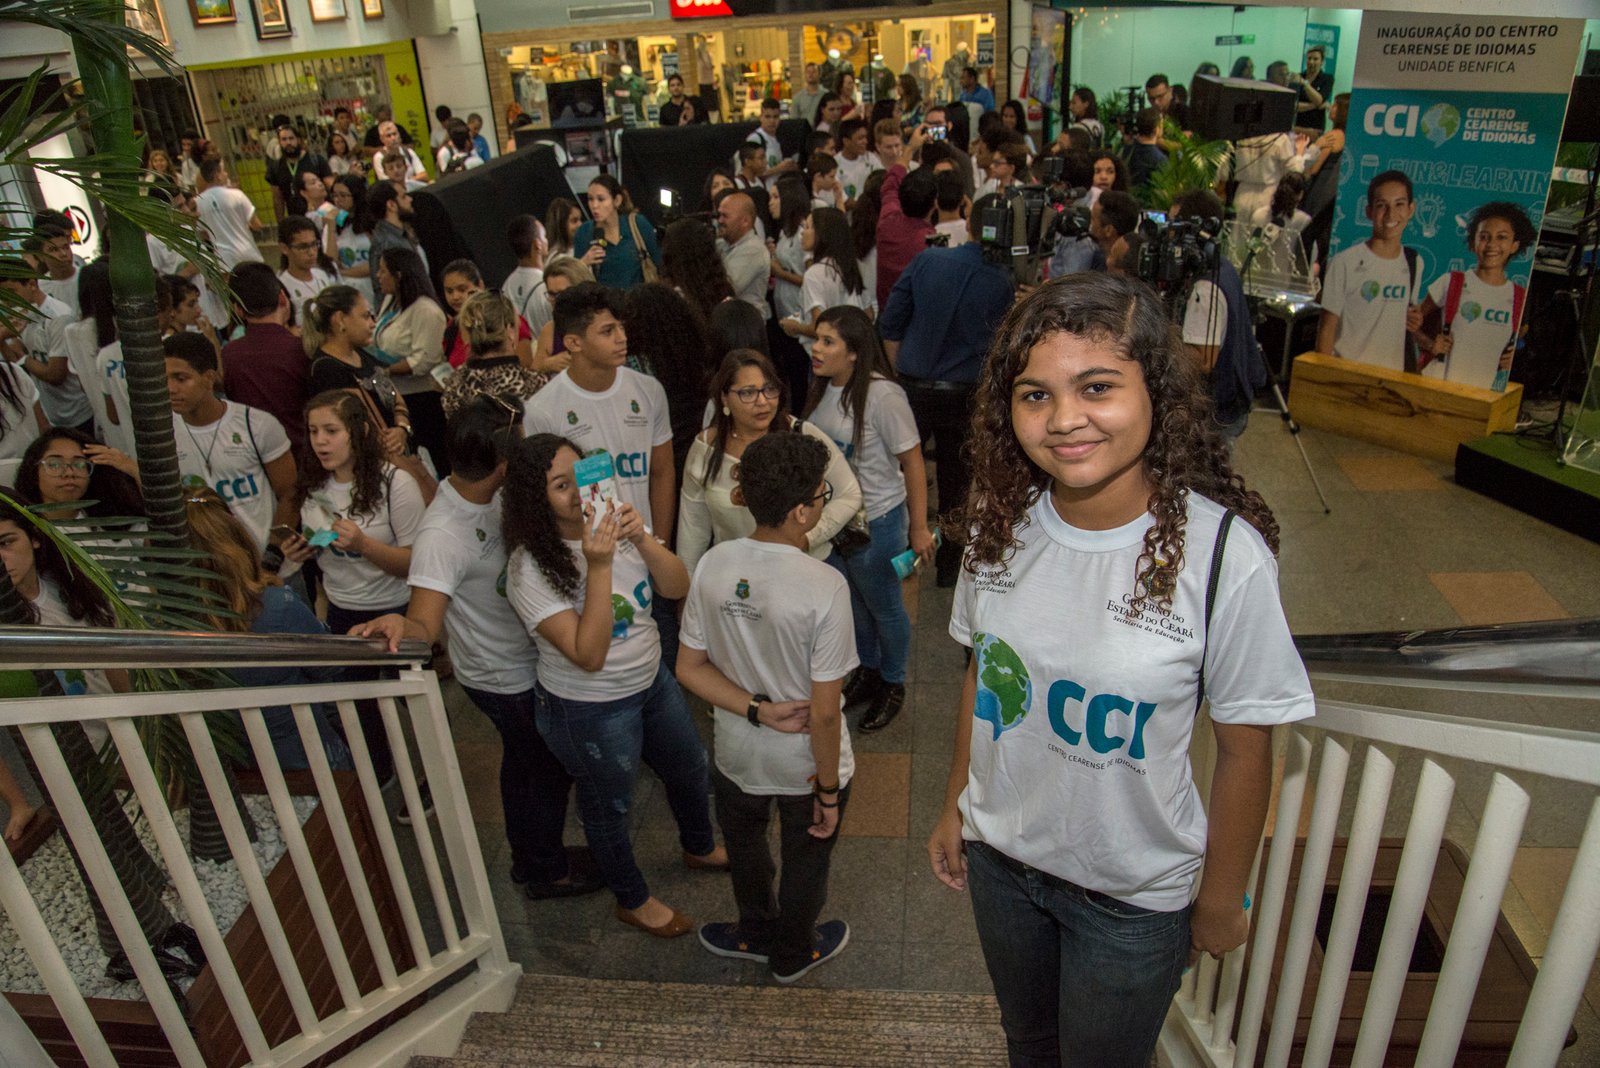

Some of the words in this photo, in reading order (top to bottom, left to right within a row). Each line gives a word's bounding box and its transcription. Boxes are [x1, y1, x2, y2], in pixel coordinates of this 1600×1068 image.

[1377, 23, 1471, 41] INAUGURAÇÃO
[1475, 26, 1495, 38] DO
[1500, 25, 1559, 38] CENTRO
[1383, 43, 1449, 55] CEARENSE
[1453, 43, 1471, 55] DE
[1475, 43, 1537, 56] IDIOMAS
[1398, 60, 1455, 73] UNIDADE
[1458, 61, 1516, 73] BENFICA
[1363, 103, 1420, 138] CCI
[1466, 107, 1516, 119] CENTRO
[1464, 119, 1529, 132] CEARENSE
[1462, 130, 1480, 141] DE
[1481, 131, 1537, 145] IDIOMAS
[1383, 285, 1406, 299] CCI
[1484, 308, 1510, 324] CCI
[616, 452, 648, 478] CCI
[215, 472, 258, 502] CCI
[1122, 593, 1172, 618] GOVERNO
[1172, 613, 1185, 624] DO
[1106, 599, 1144, 621] ESTADO
[1145, 616, 1158, 626] DO
[1160, 617, 1194, 640] CEARÁ
[1155, 628, 1185, 644] Educação
[1047, 679, 1158, 760] CCI
[1047, 743, 1067, 759] CENTRO
[1068, 754, 1106, 770] CEARENSE
[1106, 758, 1114, 768] DE
[1114, 757, 1147, 776] IDIOMAS
